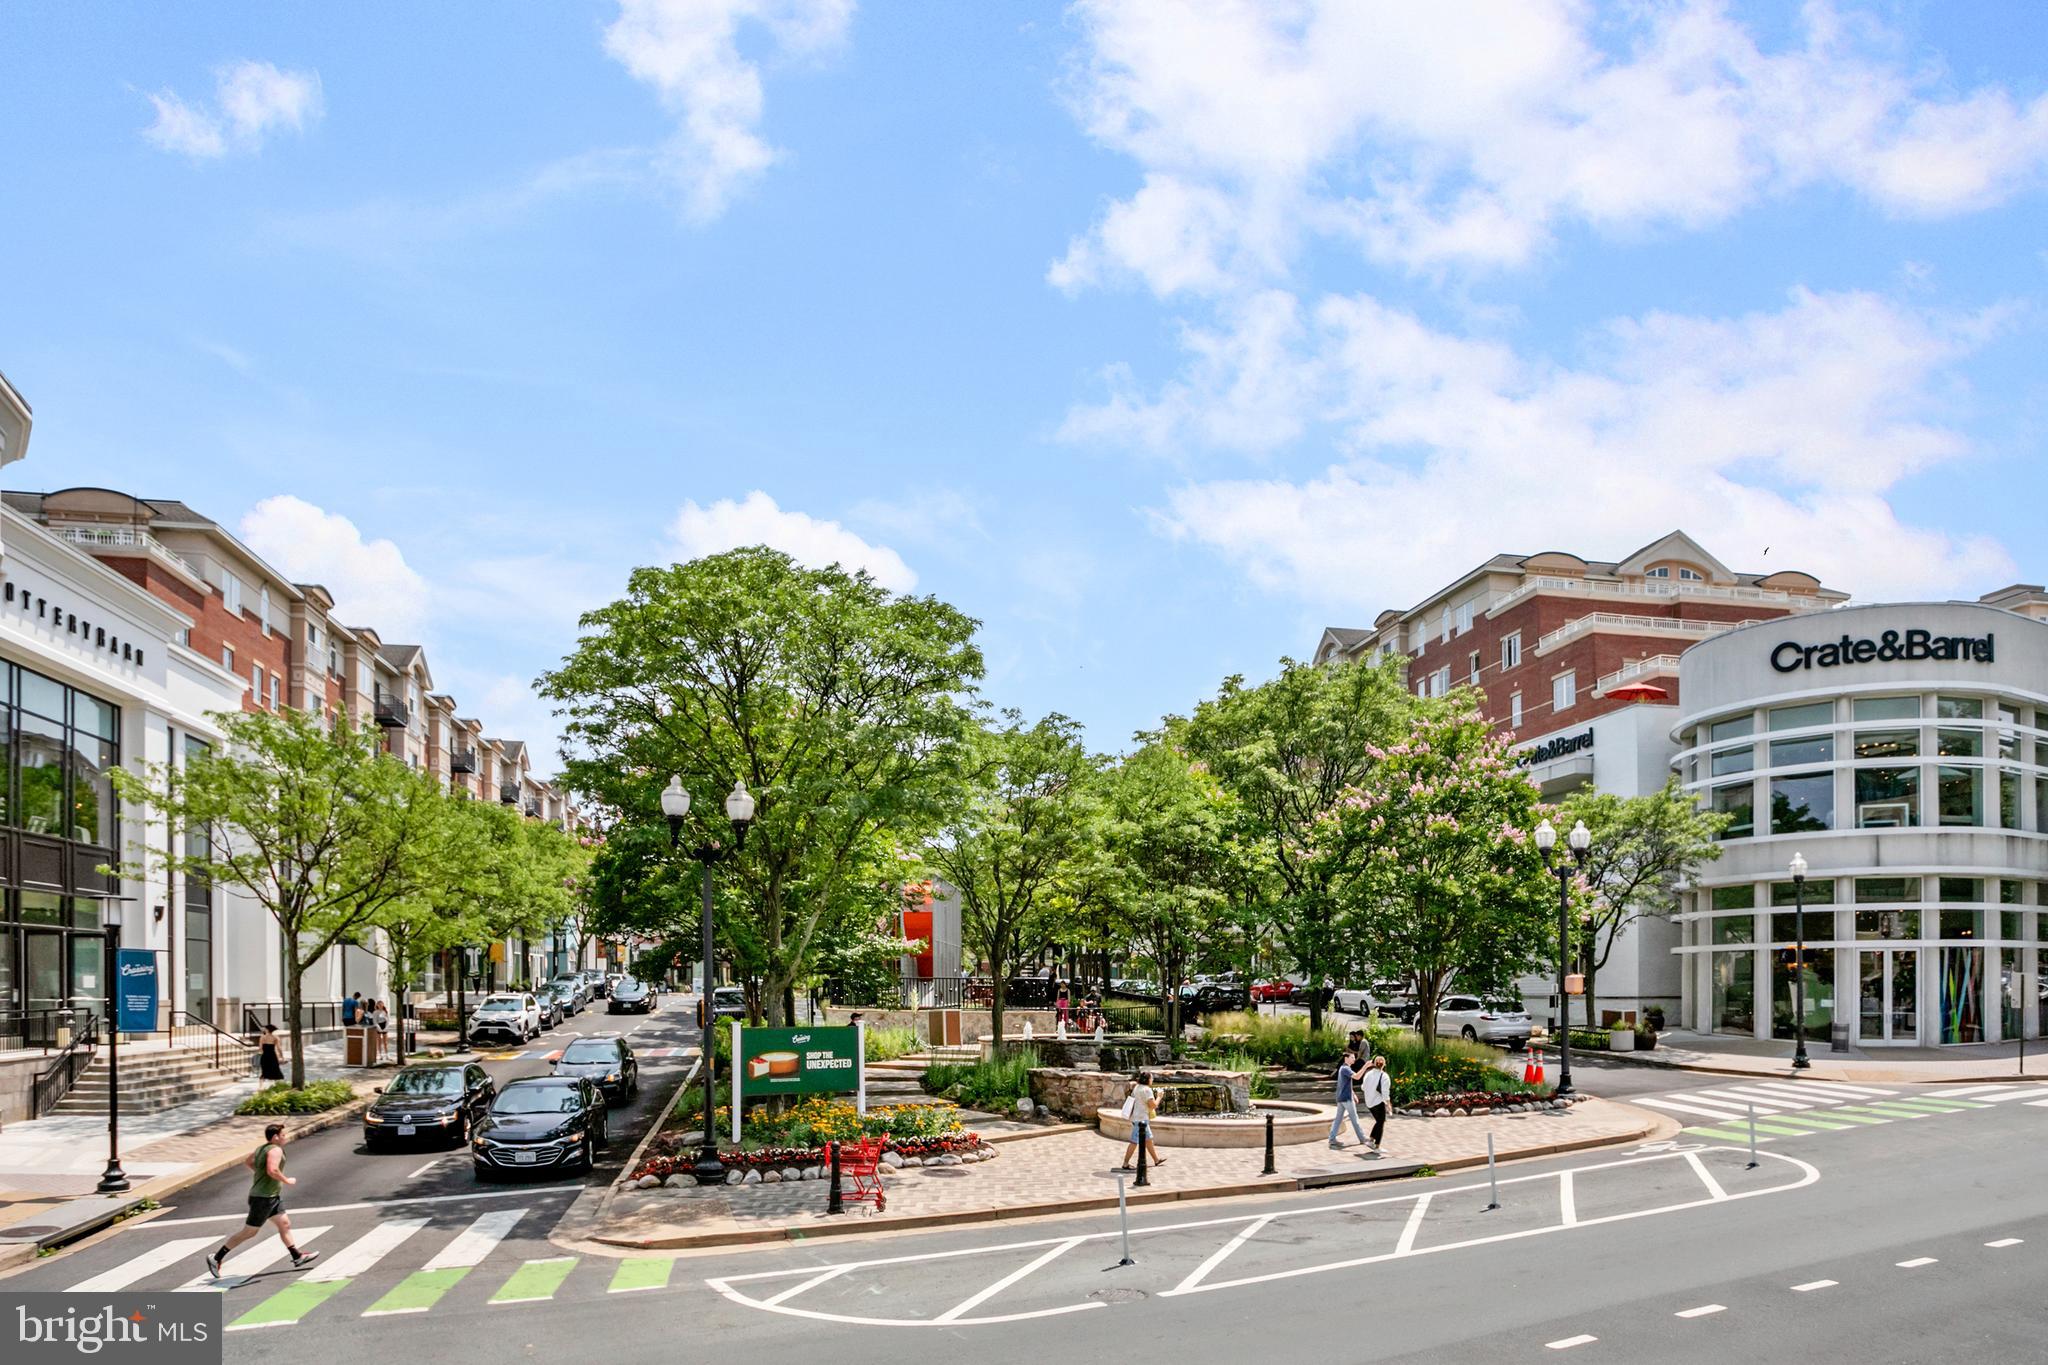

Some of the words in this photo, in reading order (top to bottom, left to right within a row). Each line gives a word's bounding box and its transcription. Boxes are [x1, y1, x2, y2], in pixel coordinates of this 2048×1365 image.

[1770, 629, 1995, 673] Crate&Barrel
[806, 1052, 822, 1060] SHOP
[822, 1051, 834, 1059] THE
[806, 1059, 852, 1070] UNEXPECTED
